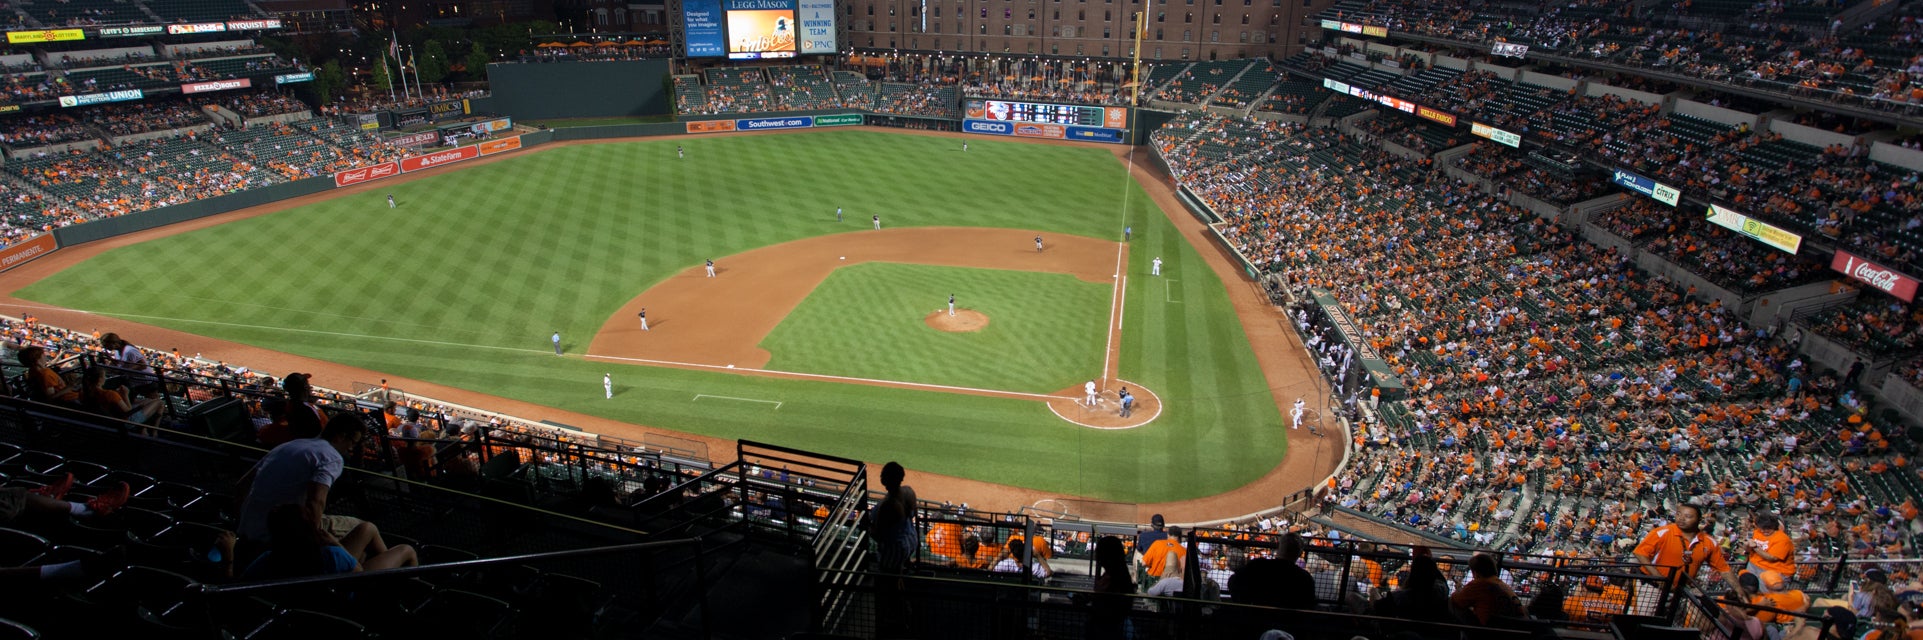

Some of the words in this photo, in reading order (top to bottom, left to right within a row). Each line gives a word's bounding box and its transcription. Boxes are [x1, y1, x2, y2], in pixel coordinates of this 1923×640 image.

[732, 0, 755, 9] LEGG
[758, 0, 788, 9] MASON
[815, 11, 819, 19] A
[228, 22, 263, 31] NYQUIST
[809, 28, 827, 36] TEAM
[814, 40, 833, 49] PNC
[193, 84, 215, 92] PIZZA
[109, 88, 142, 99] UNION
[1420, 107, 1436, 119] WELLS
[1436, 112, 1453, 125] FARGO
[971, 122, 1006, 132] GEICO
